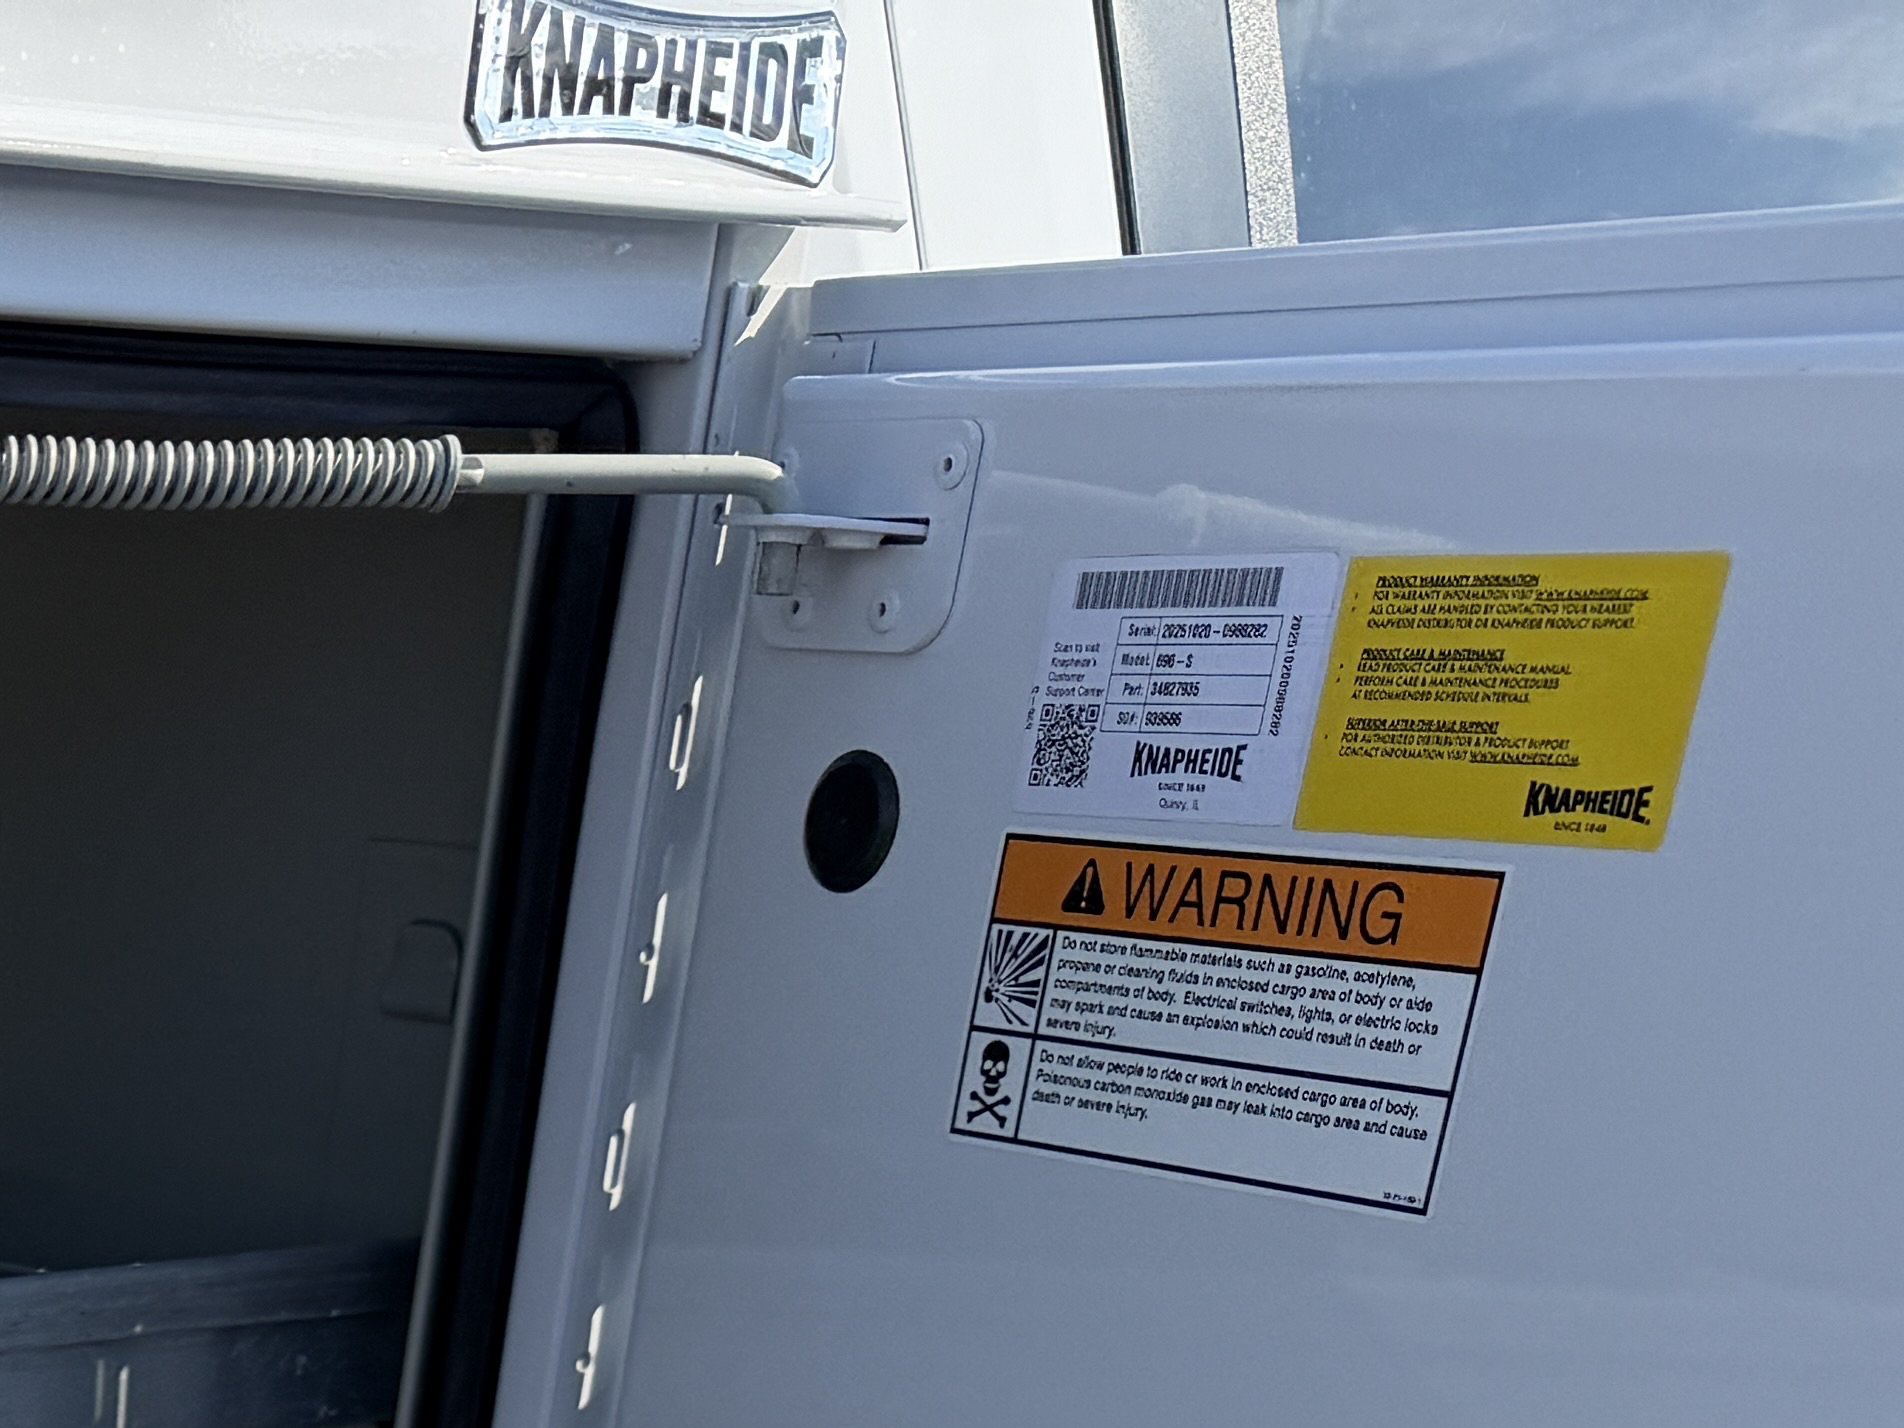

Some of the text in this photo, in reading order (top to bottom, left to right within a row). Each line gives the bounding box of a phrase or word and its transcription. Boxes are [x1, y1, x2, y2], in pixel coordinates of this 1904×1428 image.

[498, 0, 825, 159] KNAPHEIDE
[1129, 739, 1249, 783] KNAPHEIDE
[1522, 780, 1654, 825] KNAPHEIDE
[1124, 861, 1406, 946] WARNING
[1057, 957, 1433, 1013] propane or cleaning fluids in enclosed cargo area of body or side
[1062, 936, 1416, 991] Do not store flammable materials such as gasoline, acetylene,
[1046, 1016, 1117, 1040] severe injury.
[1049, 997, 1423, 1057] may spark and cause an explosion which could result in death or
[1054, 977, 1439, 1036] compartments of body. Electrical switches, lights, or electric locks
[1031, 1089, 1148, 1122] death or severe injury.
[1036, 1068, 1428, 1141] Poisonous carbon monoxide gas may leak into cargo area and cause
[1039, 1048, 1419, 1121] Do not allow people to ride or work in enclosed cargo area of body.
